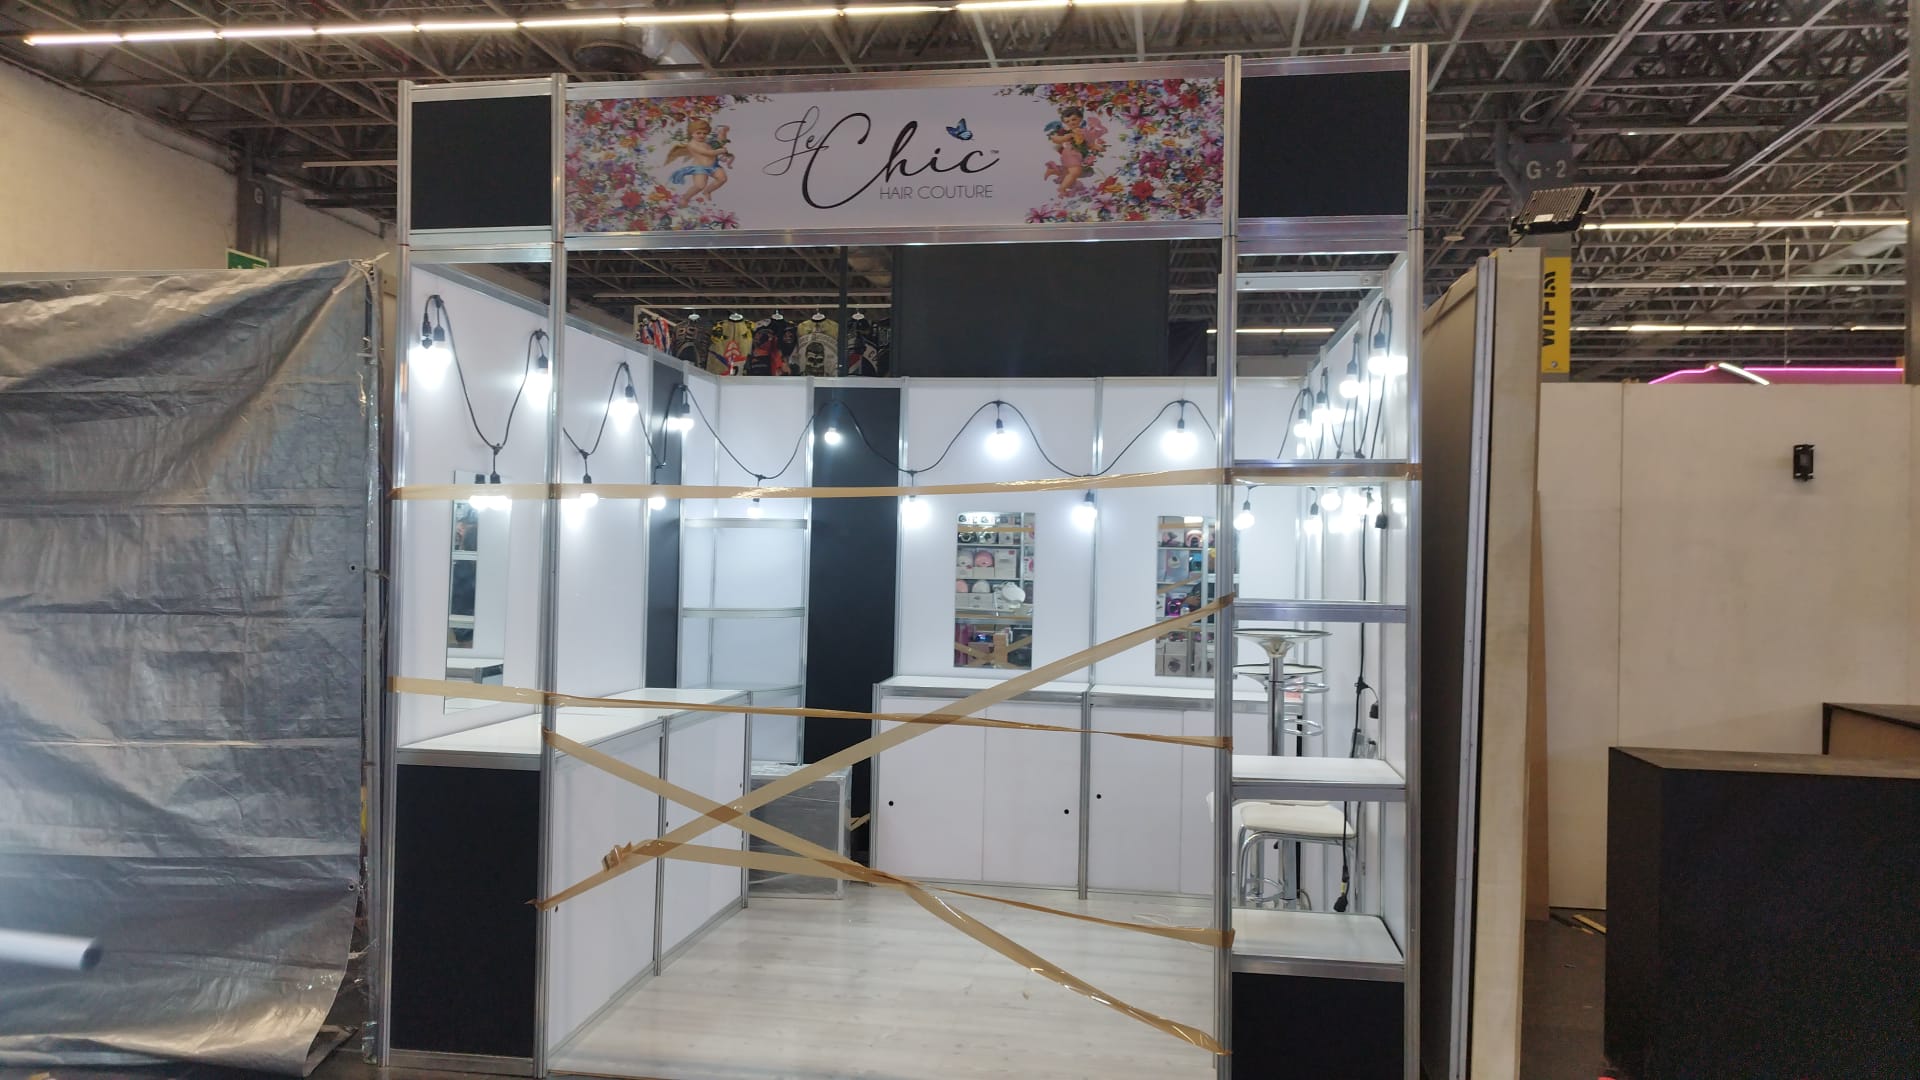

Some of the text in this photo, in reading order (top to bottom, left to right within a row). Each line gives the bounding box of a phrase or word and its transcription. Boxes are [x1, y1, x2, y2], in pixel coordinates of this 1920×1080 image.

[802, 112, 1000, 209] Chic
[880, 184, 993, 200] HAIR COUTURE
